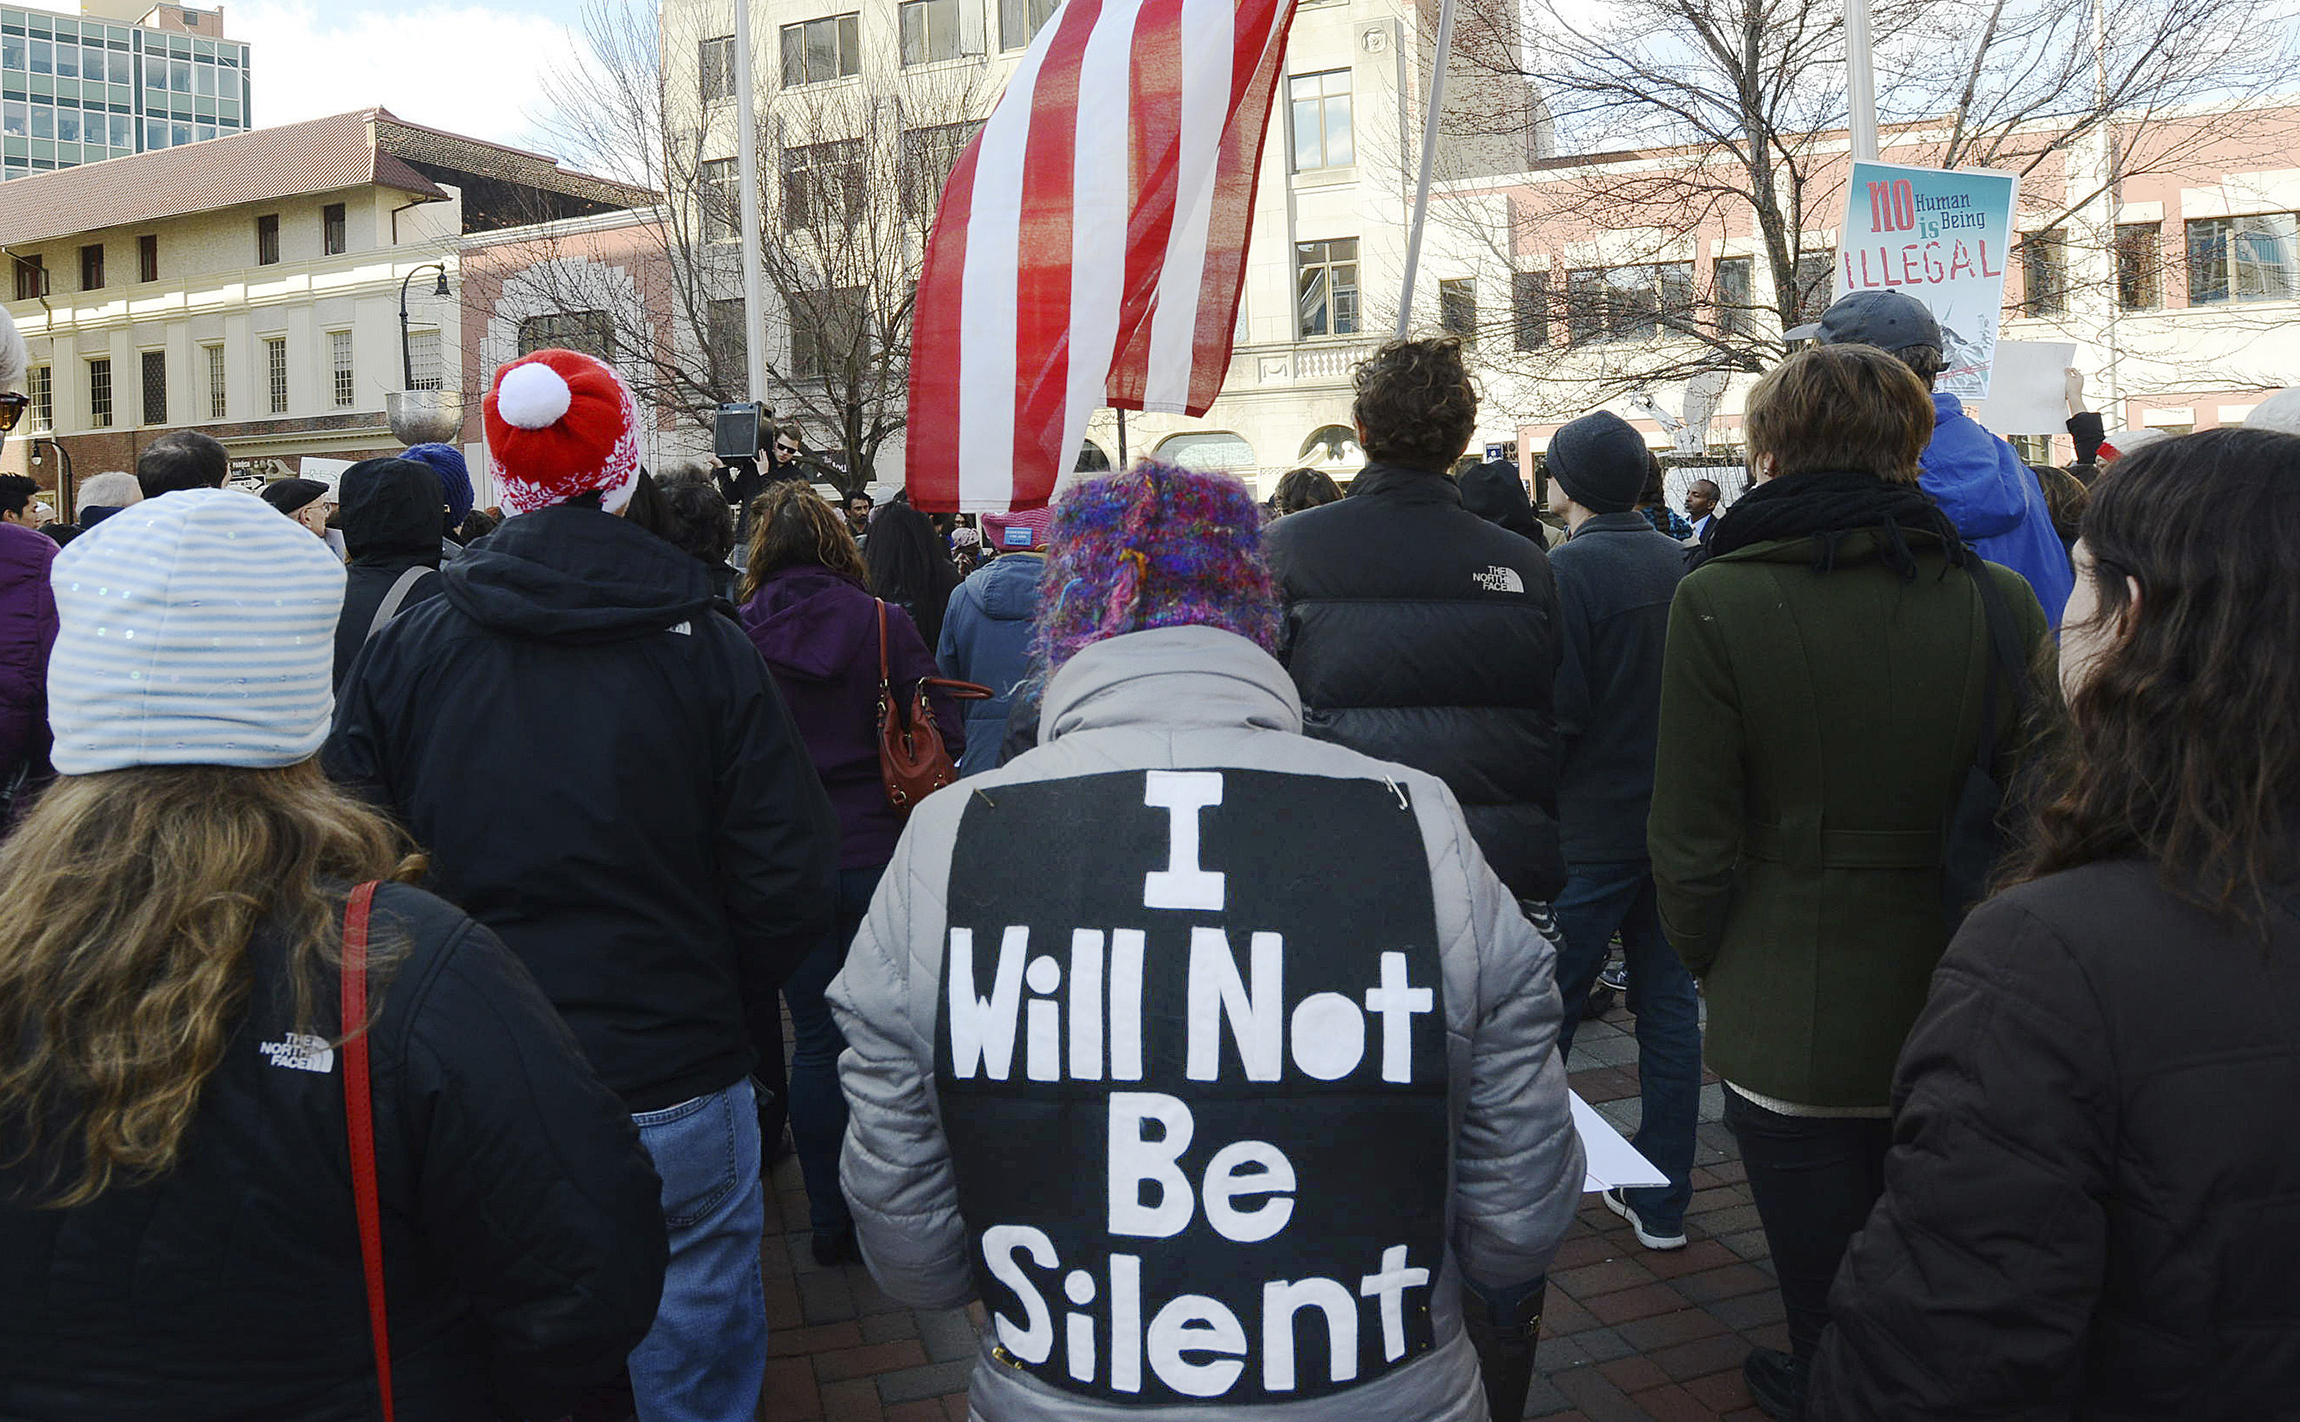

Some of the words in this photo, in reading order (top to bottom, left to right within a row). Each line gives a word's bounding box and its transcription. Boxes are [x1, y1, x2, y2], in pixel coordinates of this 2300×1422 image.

[1915, 193, 1971, 212] Human
[1919, 217, 1940, 240] is
[1941, 210, 1986, 229] Being
[1843, 239, 2001, 289] ILLEGAL
[1472, 573, 1507, 583] NORTH
[1487, 565, 1507, 575] THE
[1482, 582, 1508, 592] FACE
[1144, 770, 1225, 911] I
[949, 926, 1145, 1082] Will
[1187, 927, 1433, 1084] Not
[285, 1031, 314, 1046] THE
[259, 1041, 311, 1058] NORTH
[270, 1055, 306, 1069] FACE
[1108, 1092, 1296, 1243] Be
[983, 1225, 1430, 1397] Silent
